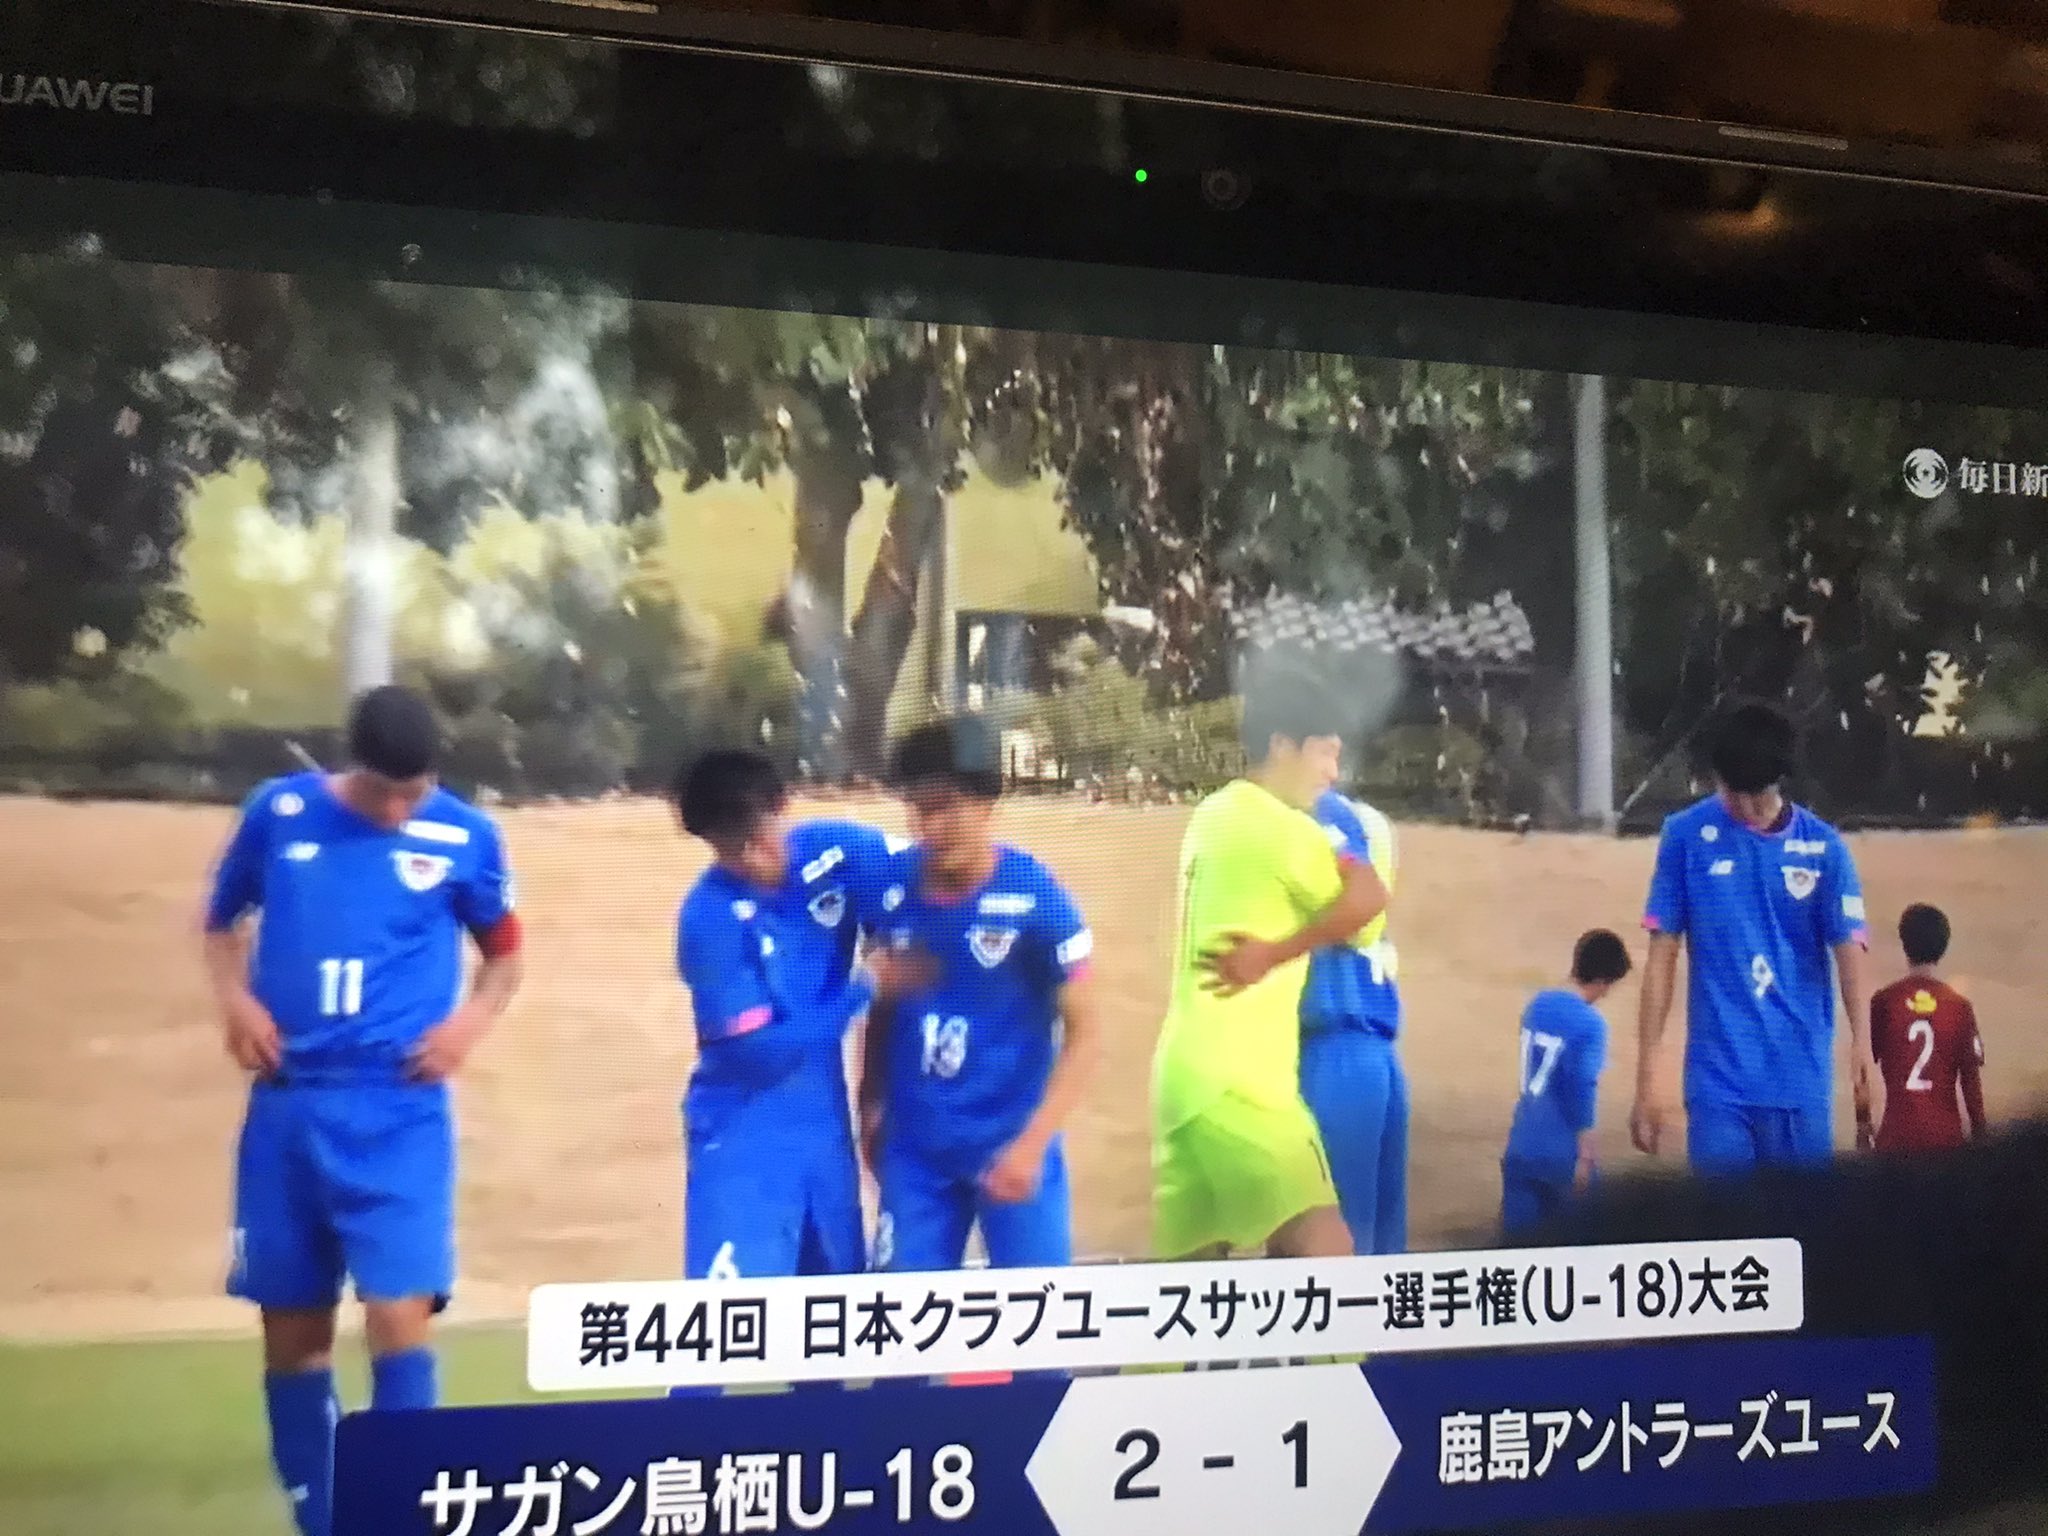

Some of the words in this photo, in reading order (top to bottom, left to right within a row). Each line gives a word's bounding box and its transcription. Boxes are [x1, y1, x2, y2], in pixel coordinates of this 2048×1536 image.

[317, 957, 365, 1017] 11
[1750, 953, 1775, 1000] 9
[1519, 1027, 1564, 1099] 17
[1905, 1018, 1935, 1092] 2
[579, 1297, 768, 1366] 第44回
[803, 1254, 1771, 1358] 日本クラブユースサッカー選手権(U-18)大会
[1113, 1427, 1161, 1501] 2
[1280, 1419, 1309, 1489] 1
[1437, 1388, 1901, 1485] 鹿島アントラーズユース
[419, 1442, 977, 1536] サガン鳥栖U-18
